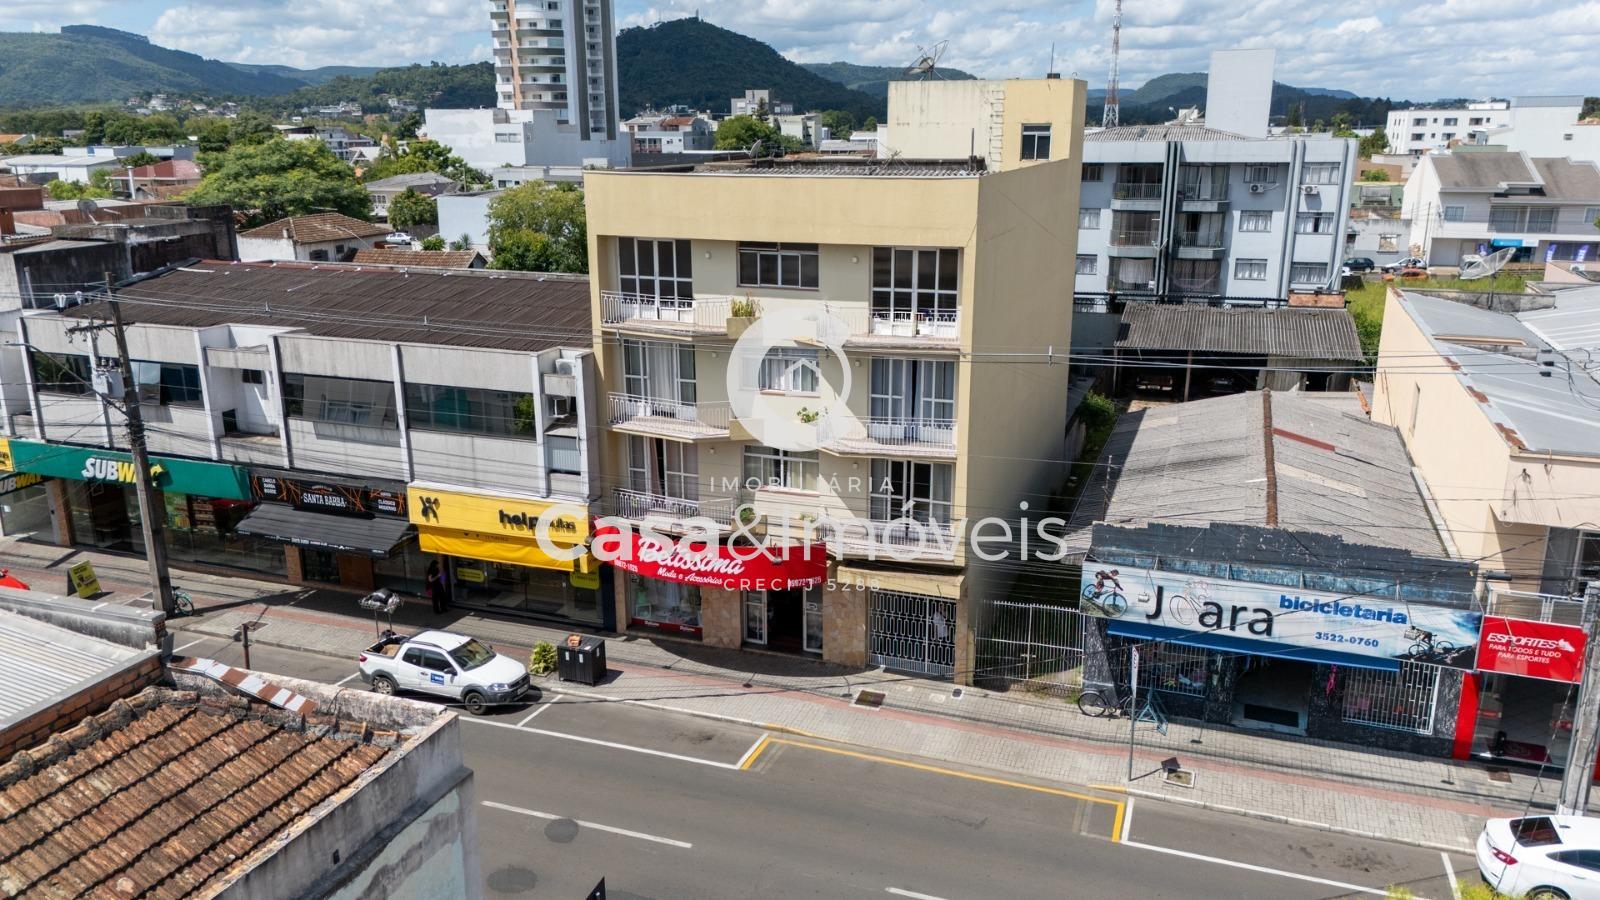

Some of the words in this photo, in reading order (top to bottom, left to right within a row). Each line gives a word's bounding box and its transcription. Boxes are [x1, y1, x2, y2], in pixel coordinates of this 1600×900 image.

[303, 493, 324, 504] SANTA
[324, 495, 346, 508] BARBA
[657, 567, 677, 579] Moda
[1279, 595, 1408, 625] bicicletaria
[1315, 631, 1379, 648] 3522-0760
[1486, 633, 1559, 649] ESPORTES
[1488, 643, 1506, 652] PARA
[1508, 645, 1533, 655] TODOS
[1541, 650, 1561, 658] TUDO
[1516, 655, 1550, 664] ESPORTES
